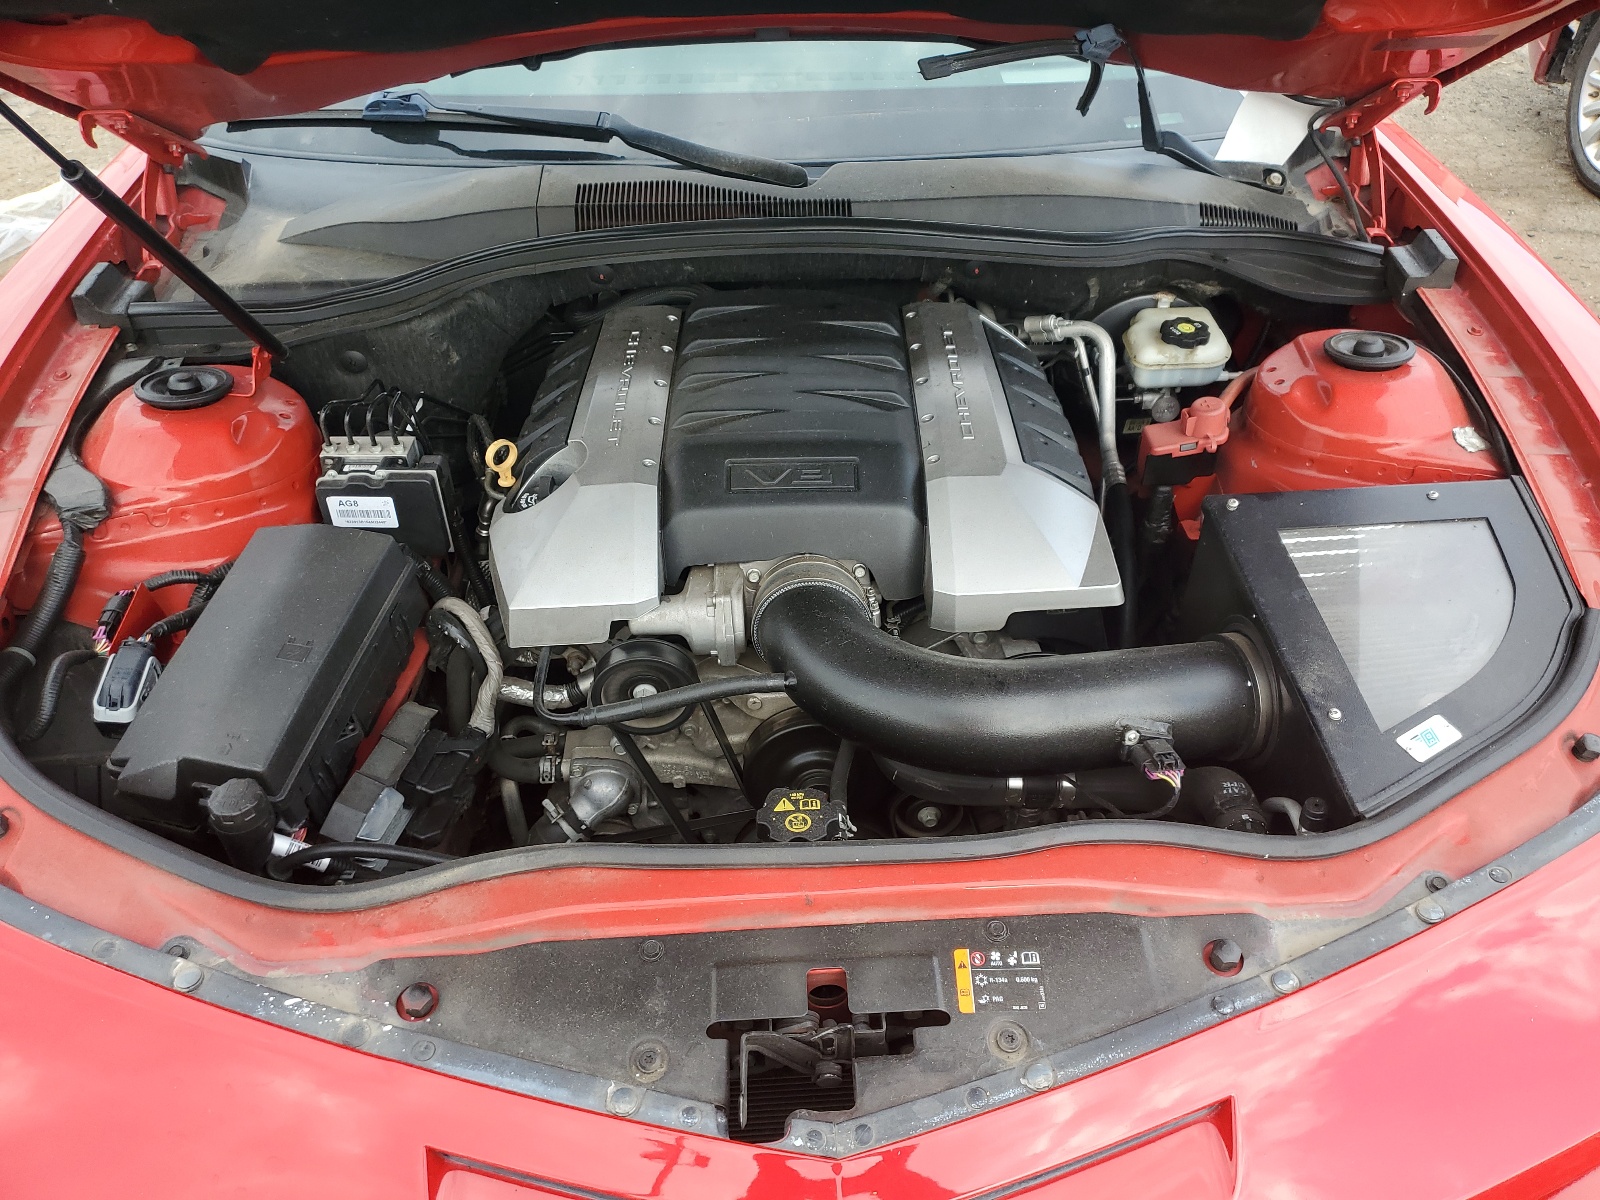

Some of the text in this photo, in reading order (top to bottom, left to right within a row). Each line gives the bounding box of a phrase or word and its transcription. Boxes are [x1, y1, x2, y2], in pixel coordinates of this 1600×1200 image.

[607, 330, 640, 447] CHEVROLET
[941, 325, 975, 440] CHEVROLET
[338, 499, 359, 508] AG8
